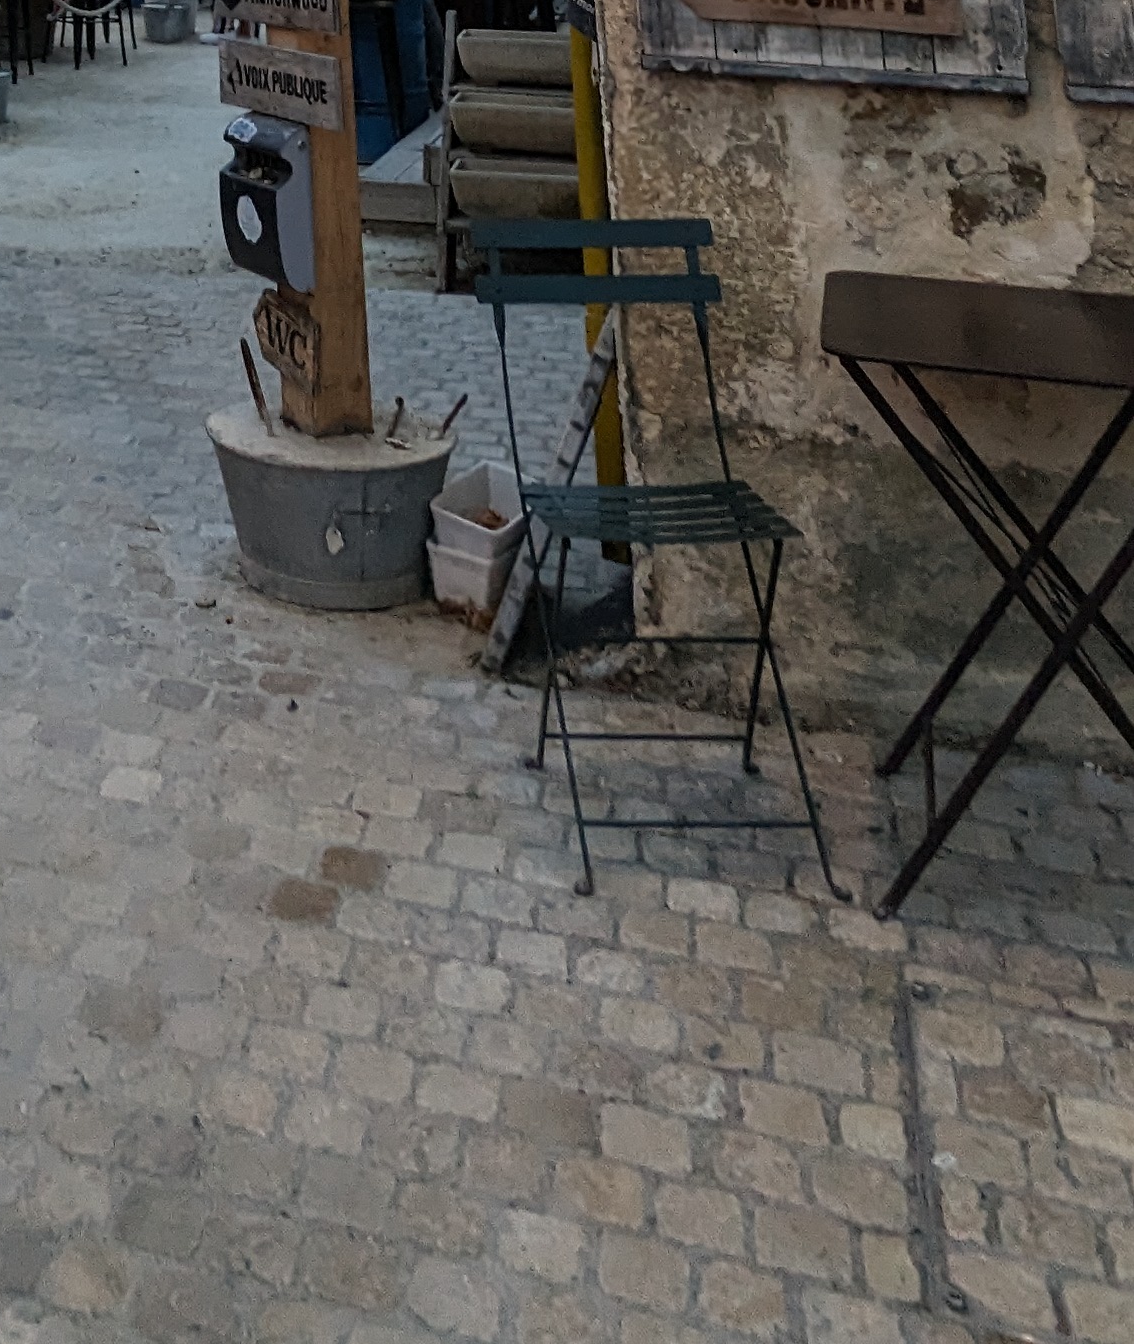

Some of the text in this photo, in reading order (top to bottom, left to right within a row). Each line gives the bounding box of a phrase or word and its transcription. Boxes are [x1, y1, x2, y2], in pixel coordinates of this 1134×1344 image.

[243, 63, 328, 105] VOIX PUBLIQUE
[265, 306, 307, 370] WC
